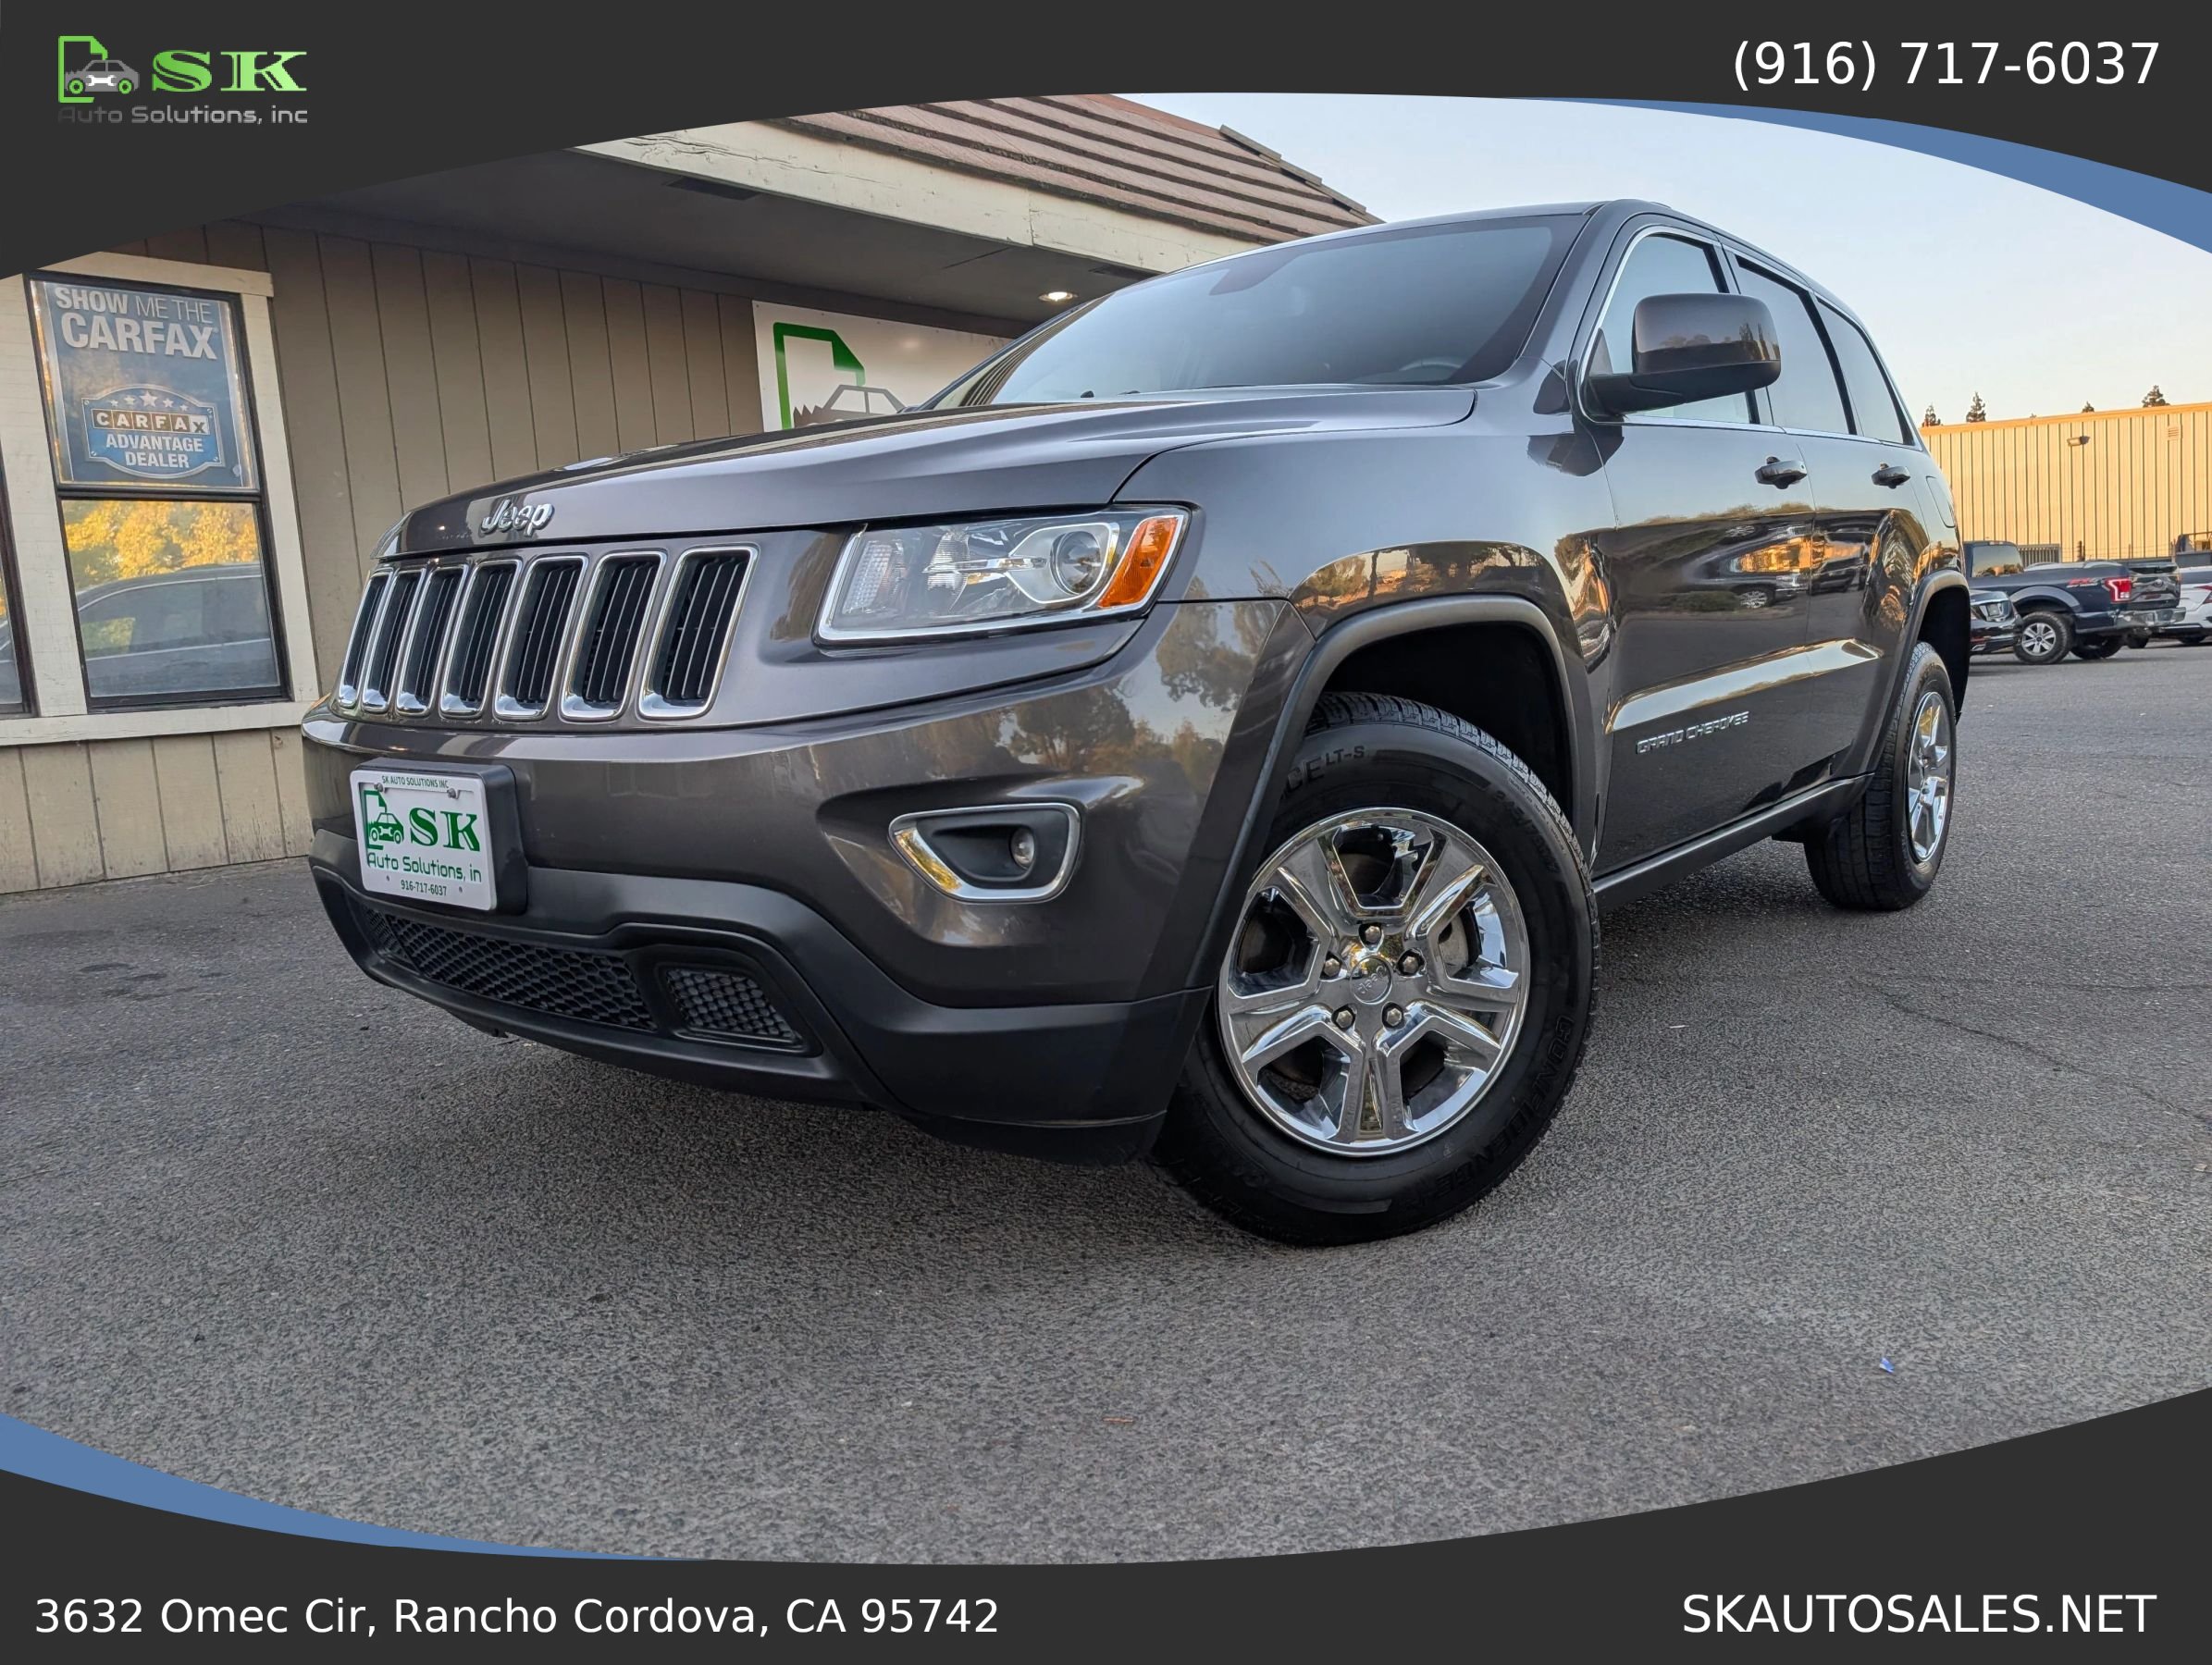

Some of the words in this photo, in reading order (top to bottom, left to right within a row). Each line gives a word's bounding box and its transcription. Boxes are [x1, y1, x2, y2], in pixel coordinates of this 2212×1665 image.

[55, 288, 128, 314] SHOW
[136, 295, 168, 319] ME
[171, 299, 213, 324] THE
[61, 313, 217, 360] CARFAX
[96, 412, 205, 434] CARFAX
[105, 434, 204, 452] ADVANTAGE
[125, 451, 190, 468] DEALER
[481, 500, 554, 536] Jeep
[1636, 729, 1685, 754] GRAND
[1686, 710, 1749, 740] CHEROKEE
[1326, 746, 1365, 765] LT-S
[382, 776, 389, 784] SK
[390, 776, 406, 785] AUTO
[407, 777, 438, 788] SOLUTIONS
[409, 807, 481, 852] SK
[367, 852, 399, 870] Auto
[402, 857, 465, 882] Solutions,
[470, 864, 482, 882] in
[401, 880, 447, 895] 916-717-6037
